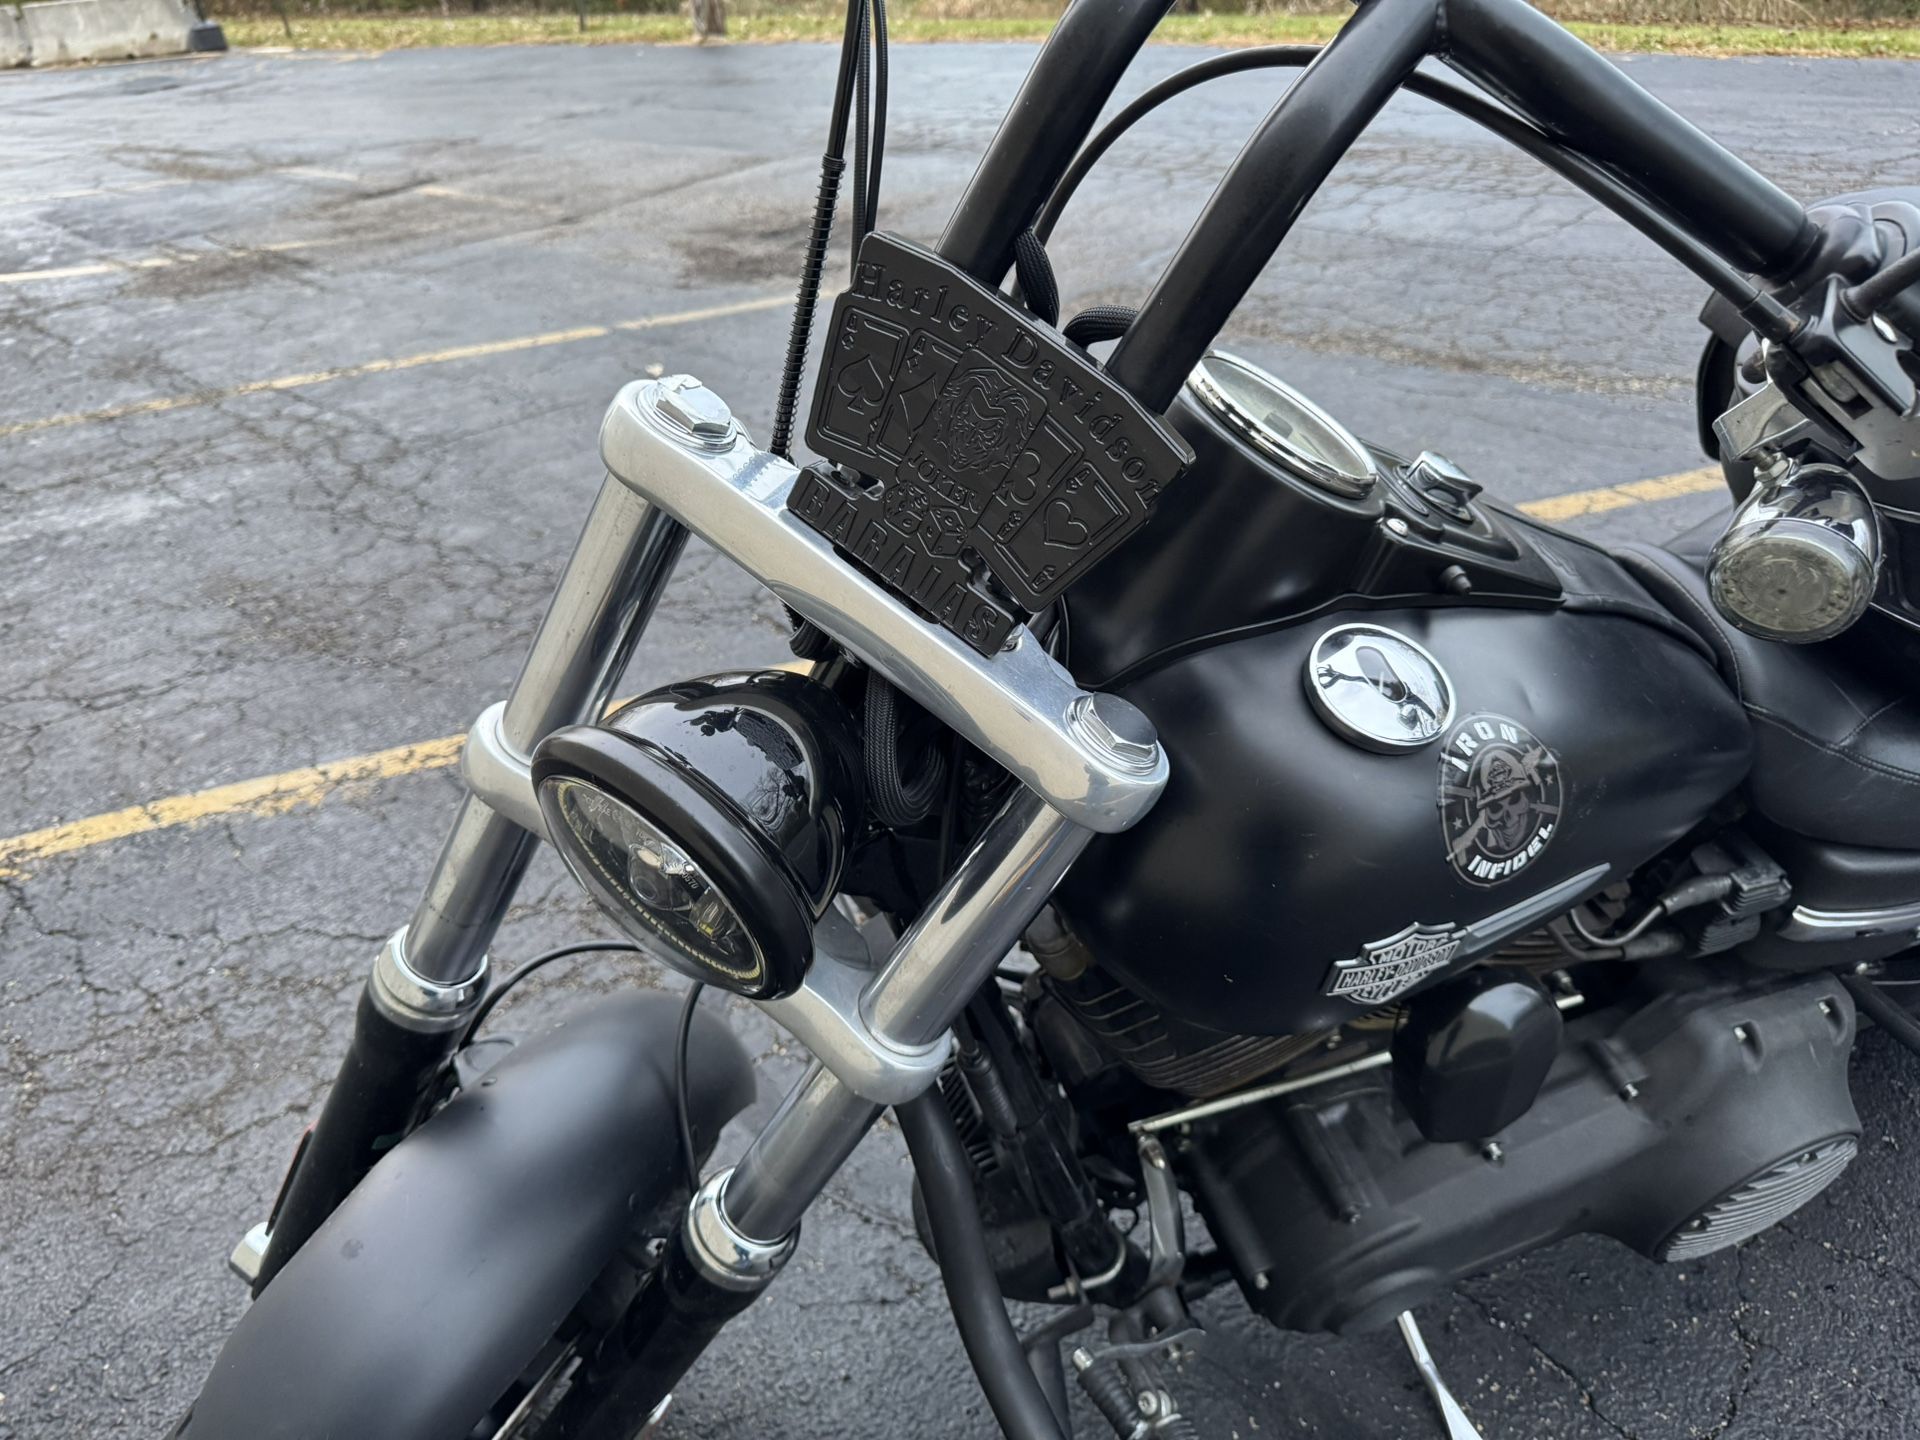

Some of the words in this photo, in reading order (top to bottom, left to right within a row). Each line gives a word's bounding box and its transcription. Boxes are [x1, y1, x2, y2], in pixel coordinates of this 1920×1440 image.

[852, 262, 998, 349] Harley
[1001, 326, 1163, 511] Davidson
[907, 450, 979, 515] JOKER
[795, 475, 998, 642] BARAJAS
[1441, 721, 1518, 773] IRON
[1467, 823, 1554, 880] INFIDEL
[1341, 943, 1457, 988] HARLEY-DAVIDSON
